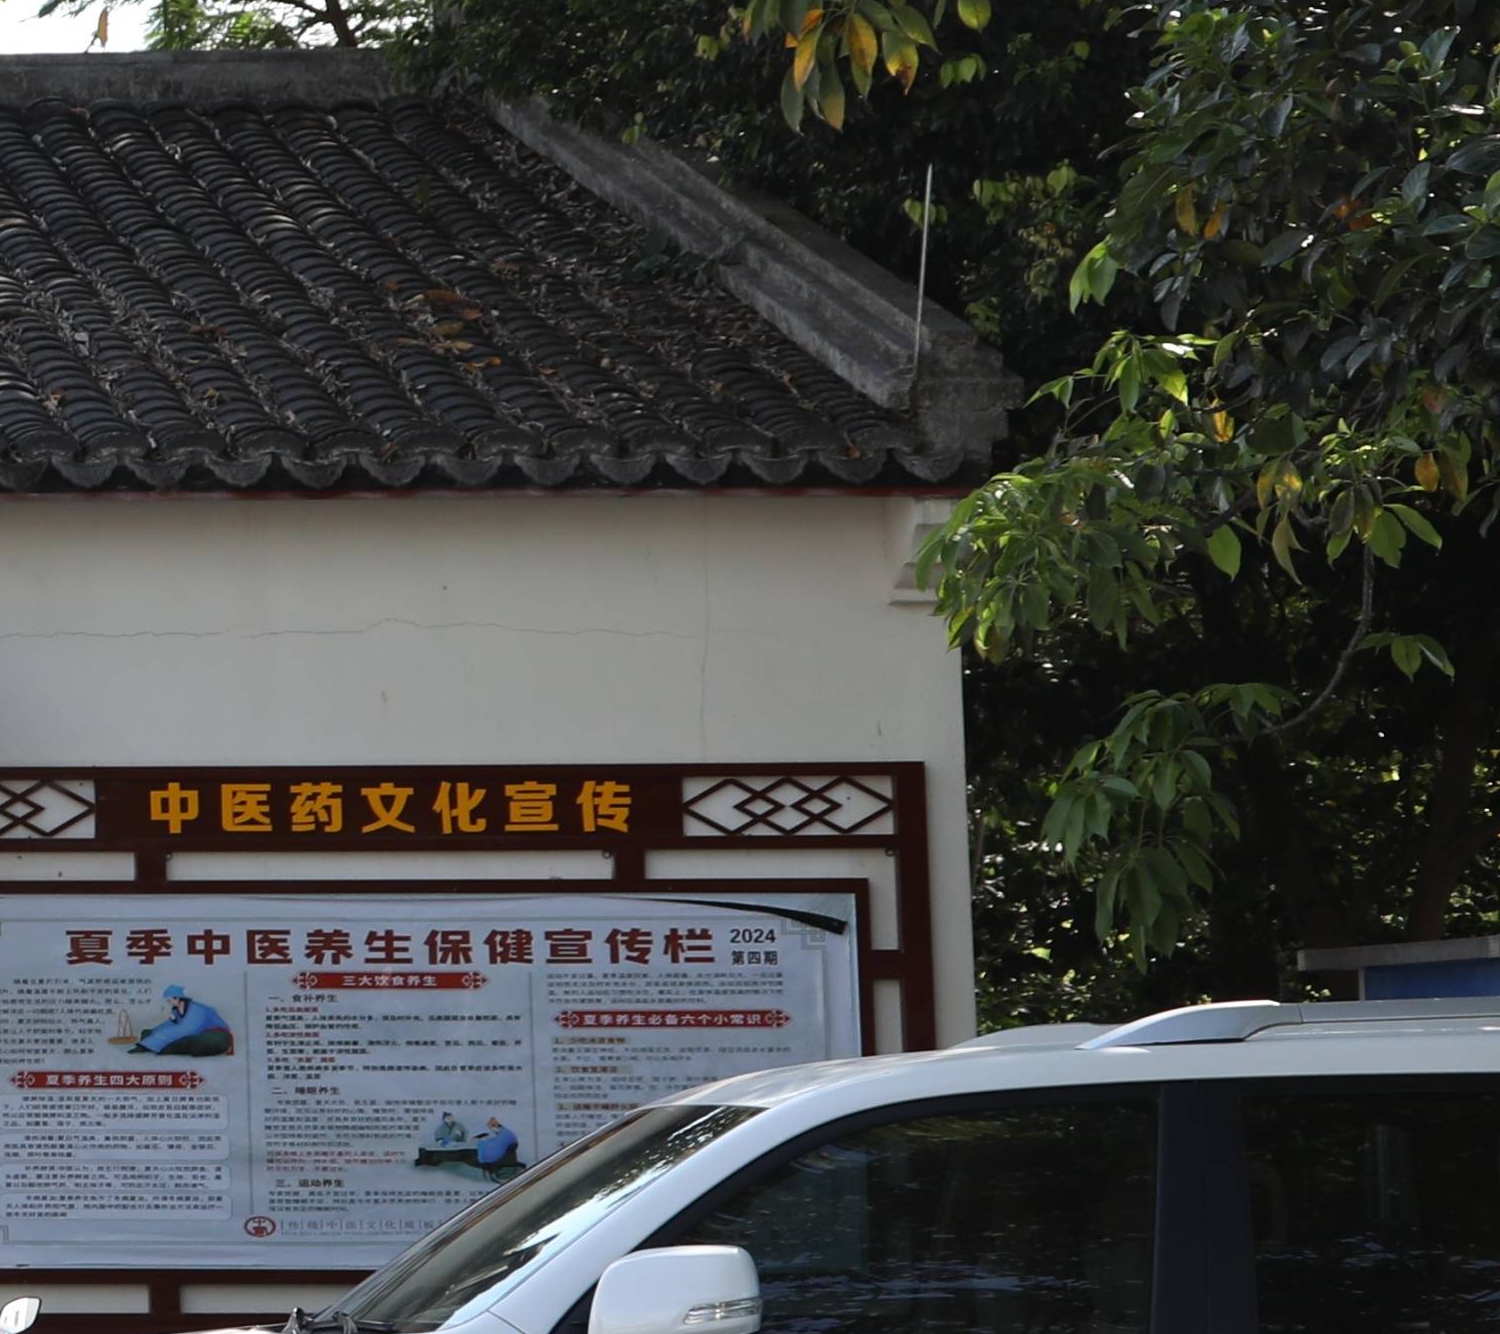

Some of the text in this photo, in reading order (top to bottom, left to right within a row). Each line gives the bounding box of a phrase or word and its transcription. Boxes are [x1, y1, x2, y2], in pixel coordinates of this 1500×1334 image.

[150, 781, 632, 834] 中医药文化宣传
[730, 929, 776, 943] 2024
[66, 928, 715, 965] 夏季中医养生保健宣传栏
[731, 951, 778, 965] 第四期
[342, 975, 437, 986] 三大饮食养生
[582, 1014, 762, 1025] 夏季养生必备六个小常识
[46, 1074, 173, 1086] 夏季养生四大原则
